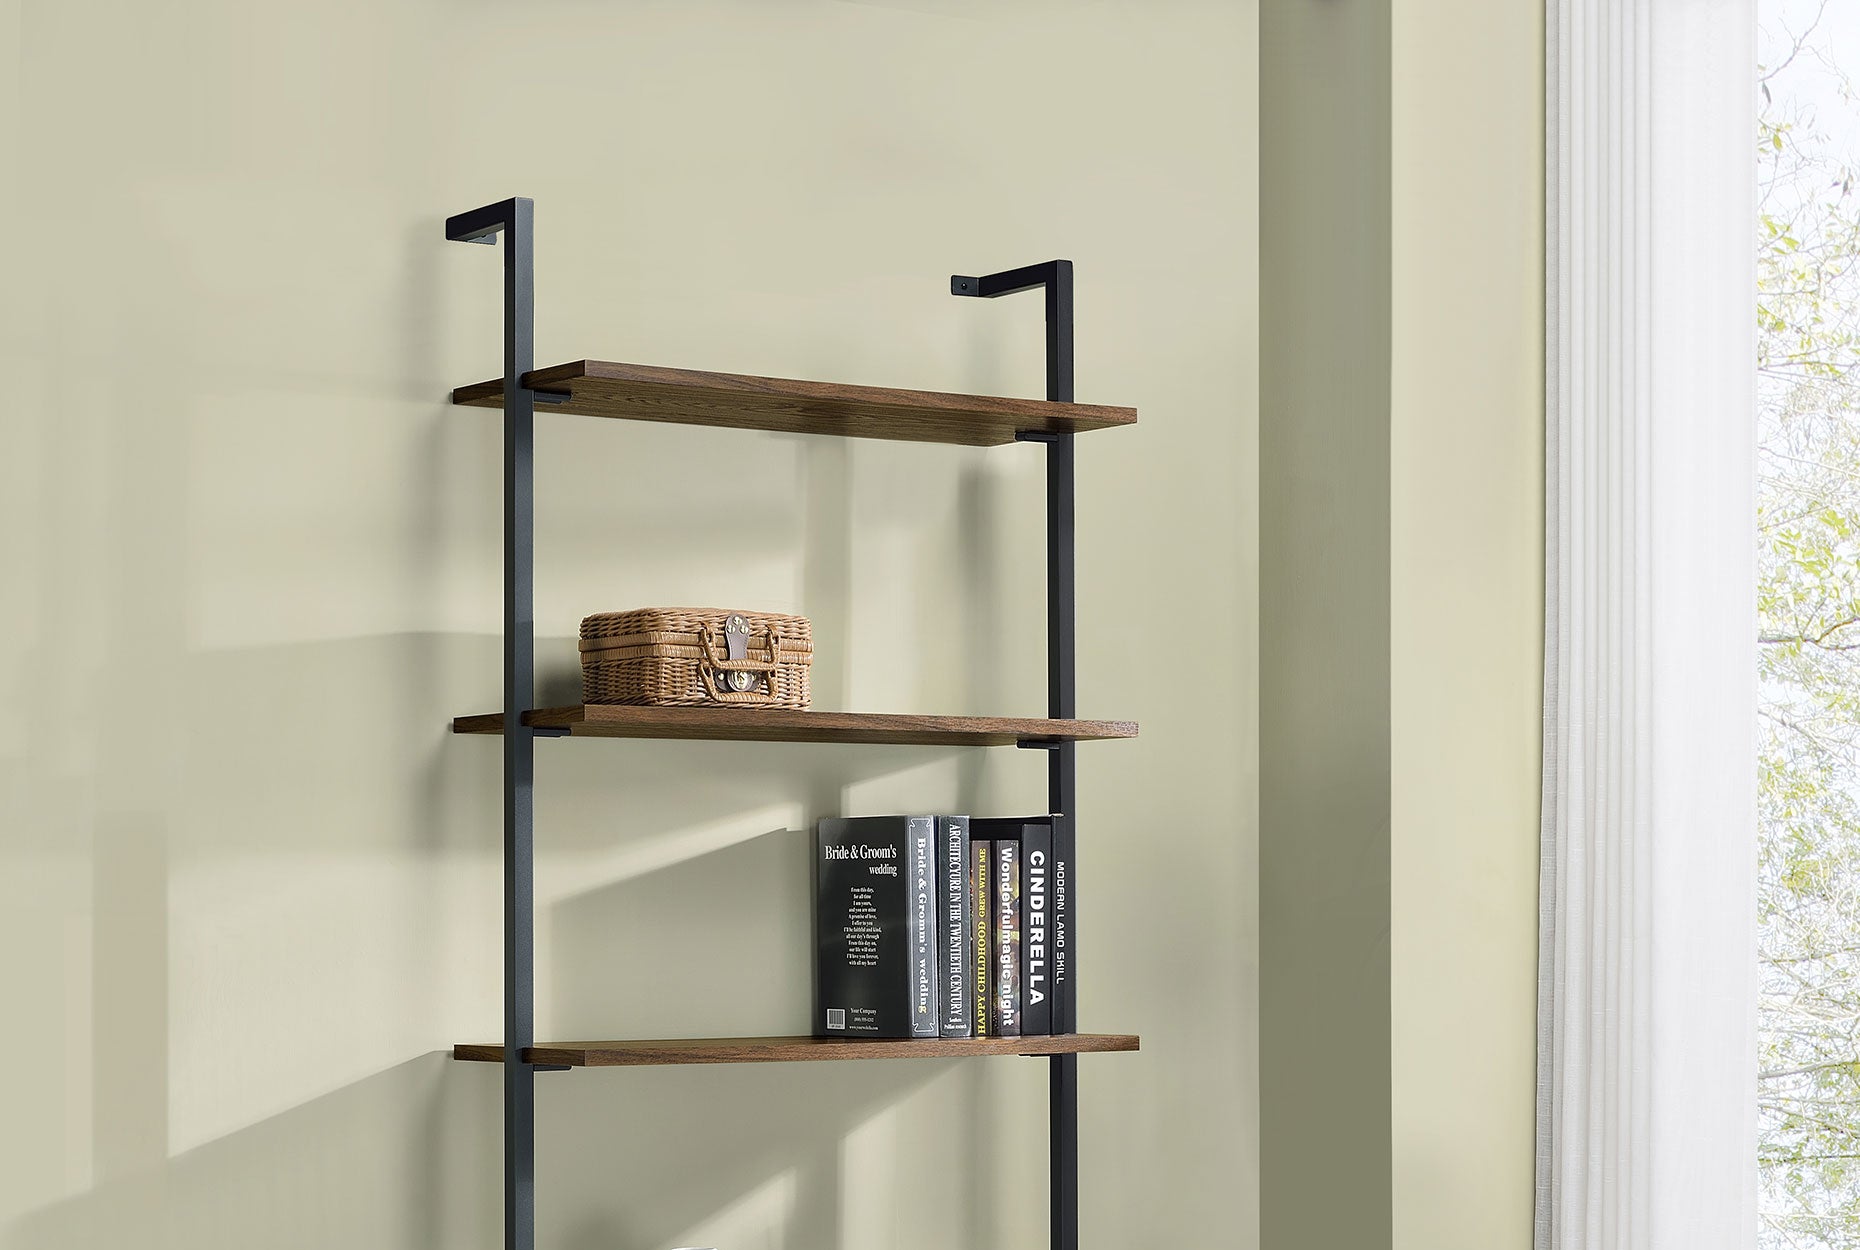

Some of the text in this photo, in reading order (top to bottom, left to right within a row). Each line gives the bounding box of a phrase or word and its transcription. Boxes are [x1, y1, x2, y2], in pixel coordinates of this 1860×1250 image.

[825, 844, 897, 860] Bride & Groom's
[917, 838, 926, 875] Bride
[979, 848, 986, 862] ME
[869, 863, 898, 877] wedding
[918, 878, 926, 890] &
[950, 892, 961, 902] IN
[950, 903, 961, 922] THE
[978, 891, 986, 918] GREW
[1030, 850, 1045, 1006] CINDERELLA
[1056, 914, 1065, 948] LAMO
[950, 923, 962, 974] TWENTIETH
[977, 921, 986, 993] CHILDHOOD
[1056, 951, 1065, 985] SKILL
[918, 959, 928, 1014] wedding
[950, 975, 962, 1015] CENTURY
[977, 995, 986, 1034] HAPPY
[1001, 984, 1014, 1026] night
